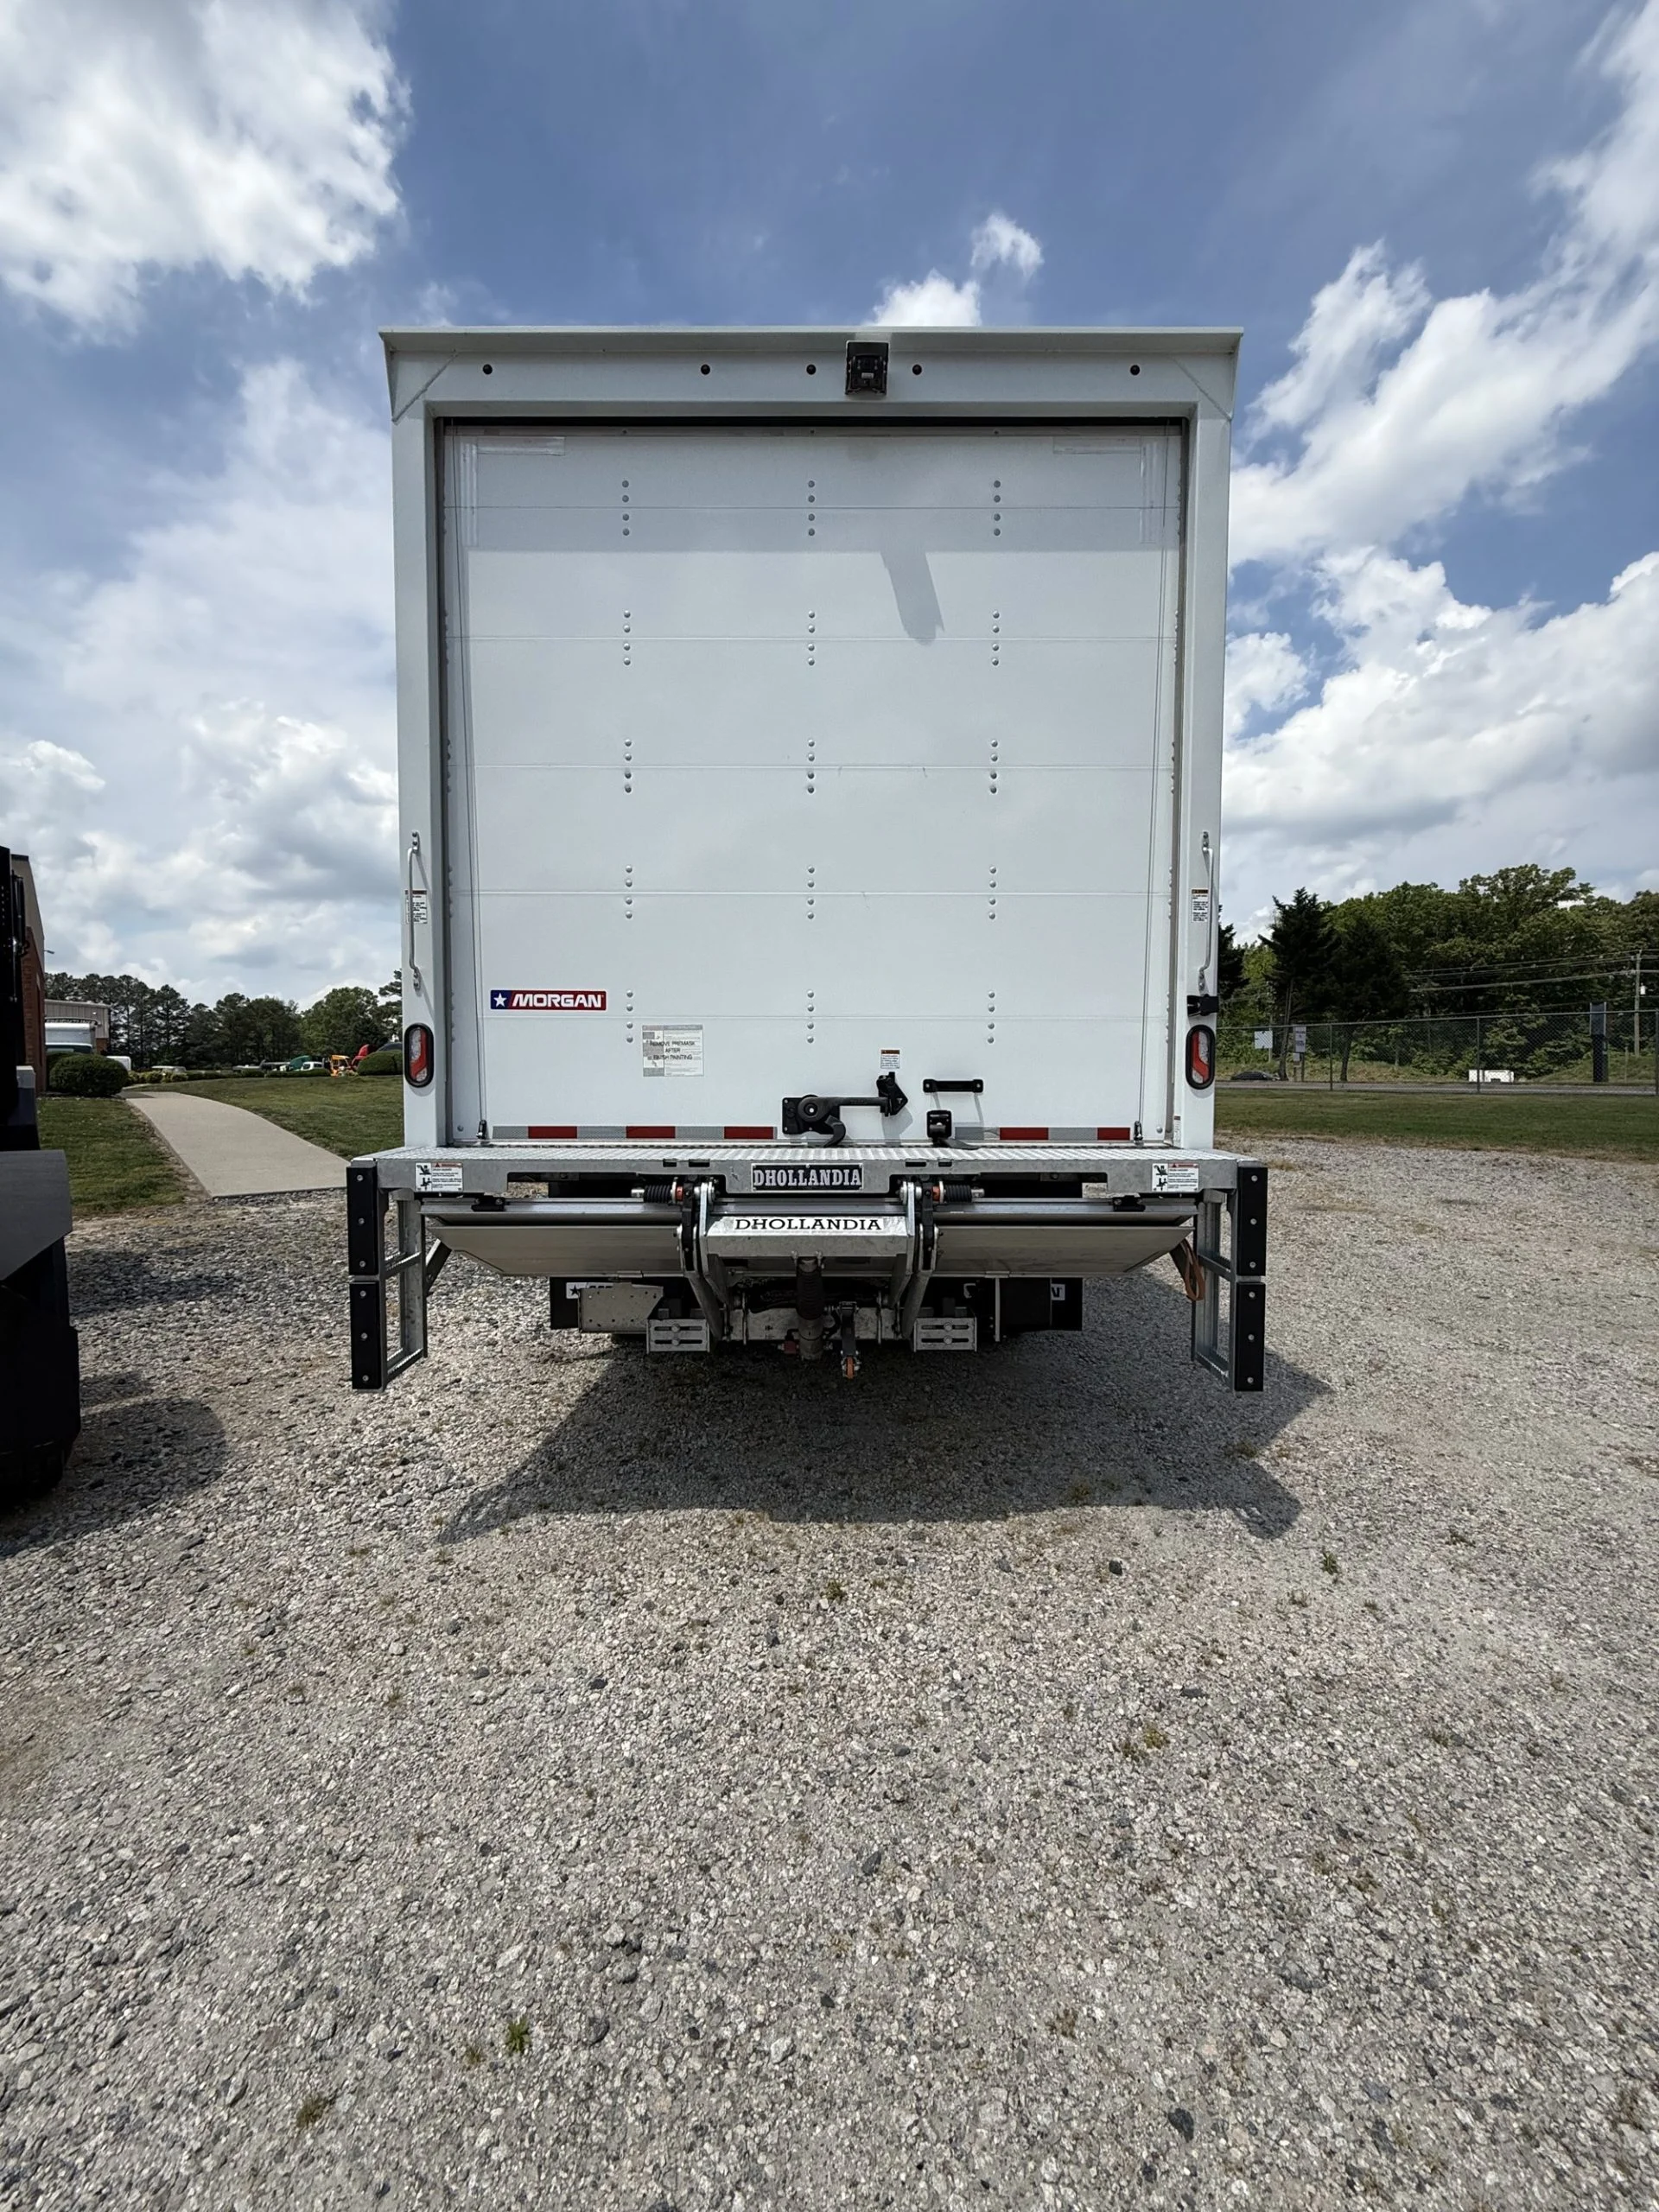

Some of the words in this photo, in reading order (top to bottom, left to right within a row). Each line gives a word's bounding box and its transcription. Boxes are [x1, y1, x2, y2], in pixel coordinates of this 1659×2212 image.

[512, 994, 602, 1007] MORGAN
[753, 1169, 861, 1187] DHOLLANDIA
[735, 1218, 882, 1230] DHOLLANDIA
